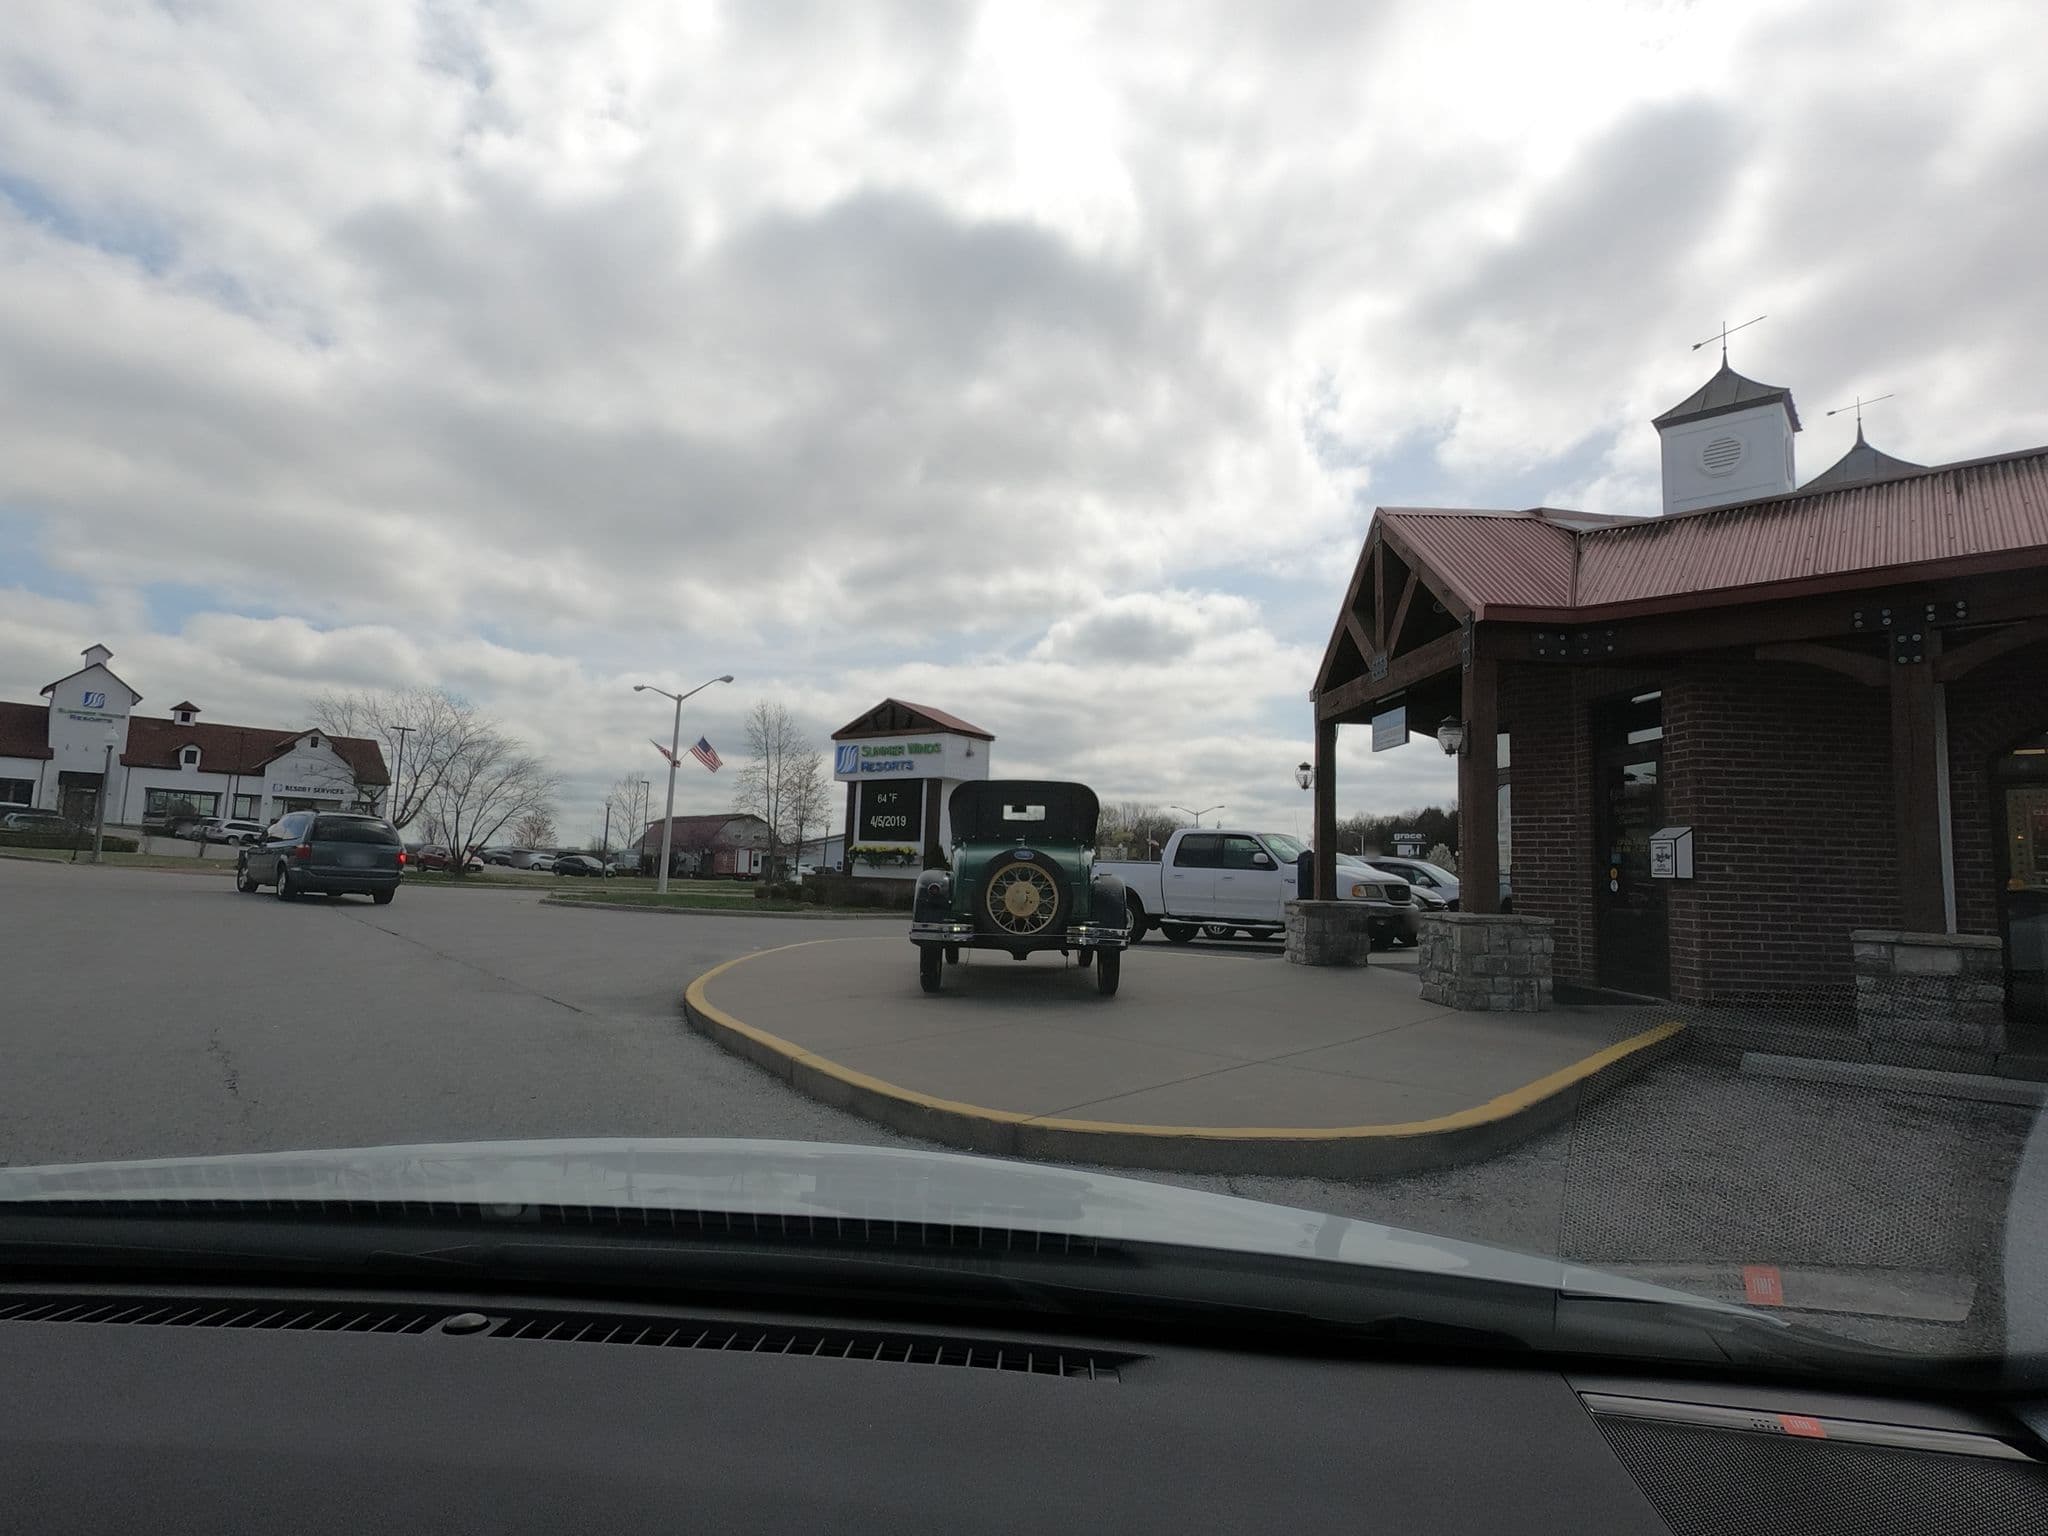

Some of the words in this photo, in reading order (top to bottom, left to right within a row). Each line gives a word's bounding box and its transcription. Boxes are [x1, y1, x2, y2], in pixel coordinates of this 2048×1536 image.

[860, 745, 906, 757] SUMMER
[907, 742, 942, 755] WINDS
[860, 760, 914, 772] RESORTS
[877, 793, 887, 804] 64
[870, 815, 907, 828] 4/5/2019
